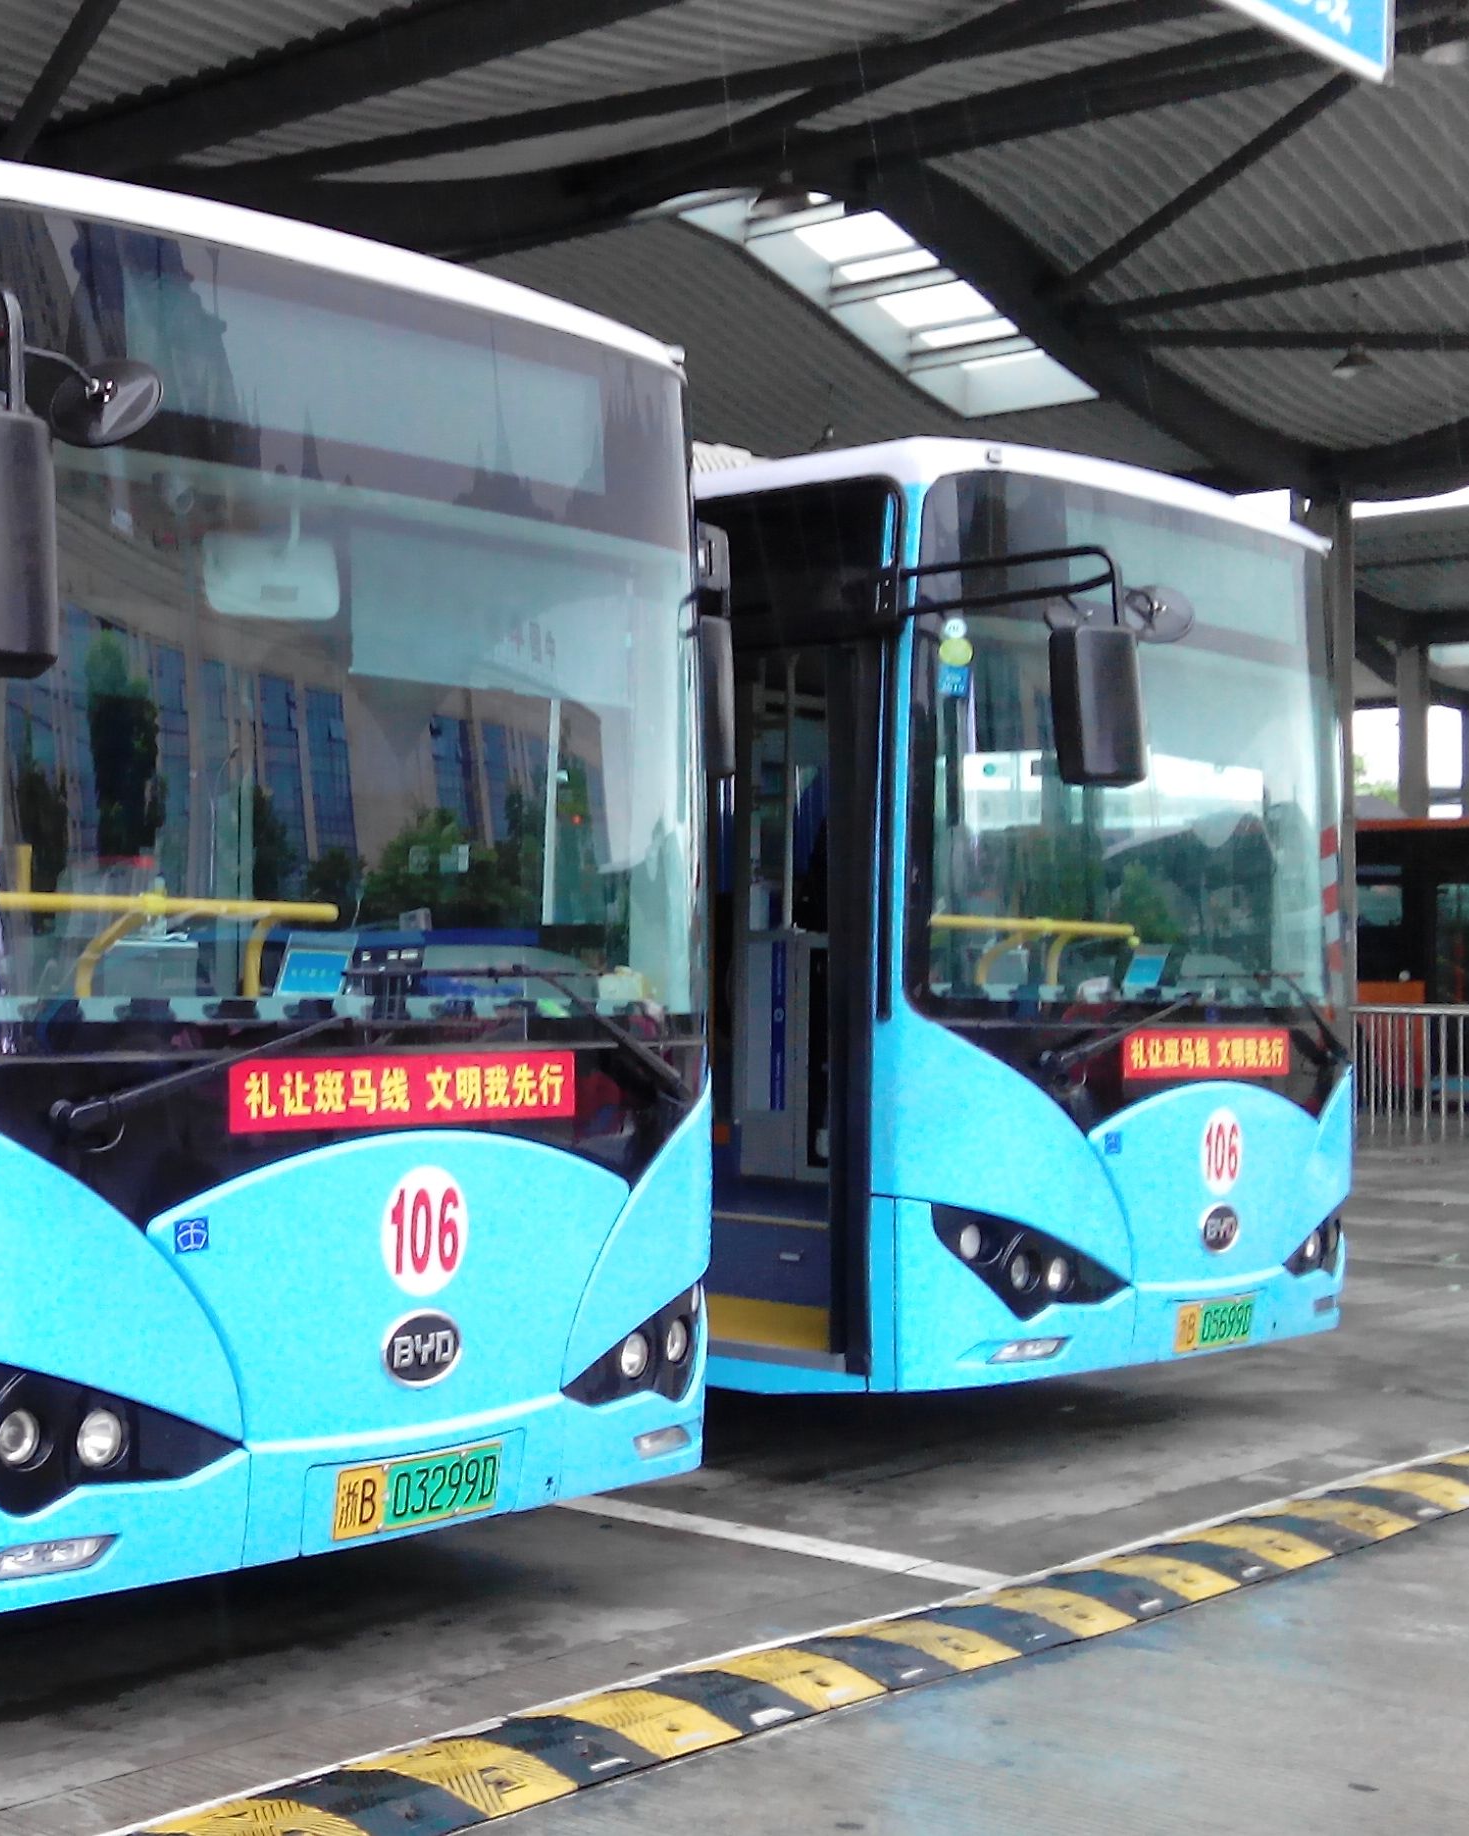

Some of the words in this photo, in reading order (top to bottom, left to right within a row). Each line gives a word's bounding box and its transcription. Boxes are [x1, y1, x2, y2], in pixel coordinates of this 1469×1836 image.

[1130, 1036, 1211, 1069] 礼让斑马线
[1216, 1036, 1284, 1068] 文明我先行
[244, 1067, 411, 1119] 礼让斑马线
[426, 1063, 564, 1110] 文明我先行
[1205, 1122, 1239, 1181] 106
[391, 1188, 459, 1275] 106
[1206, 1216, 1237, 1241] BYD
[393, 1330, 454, 1368] BYD
